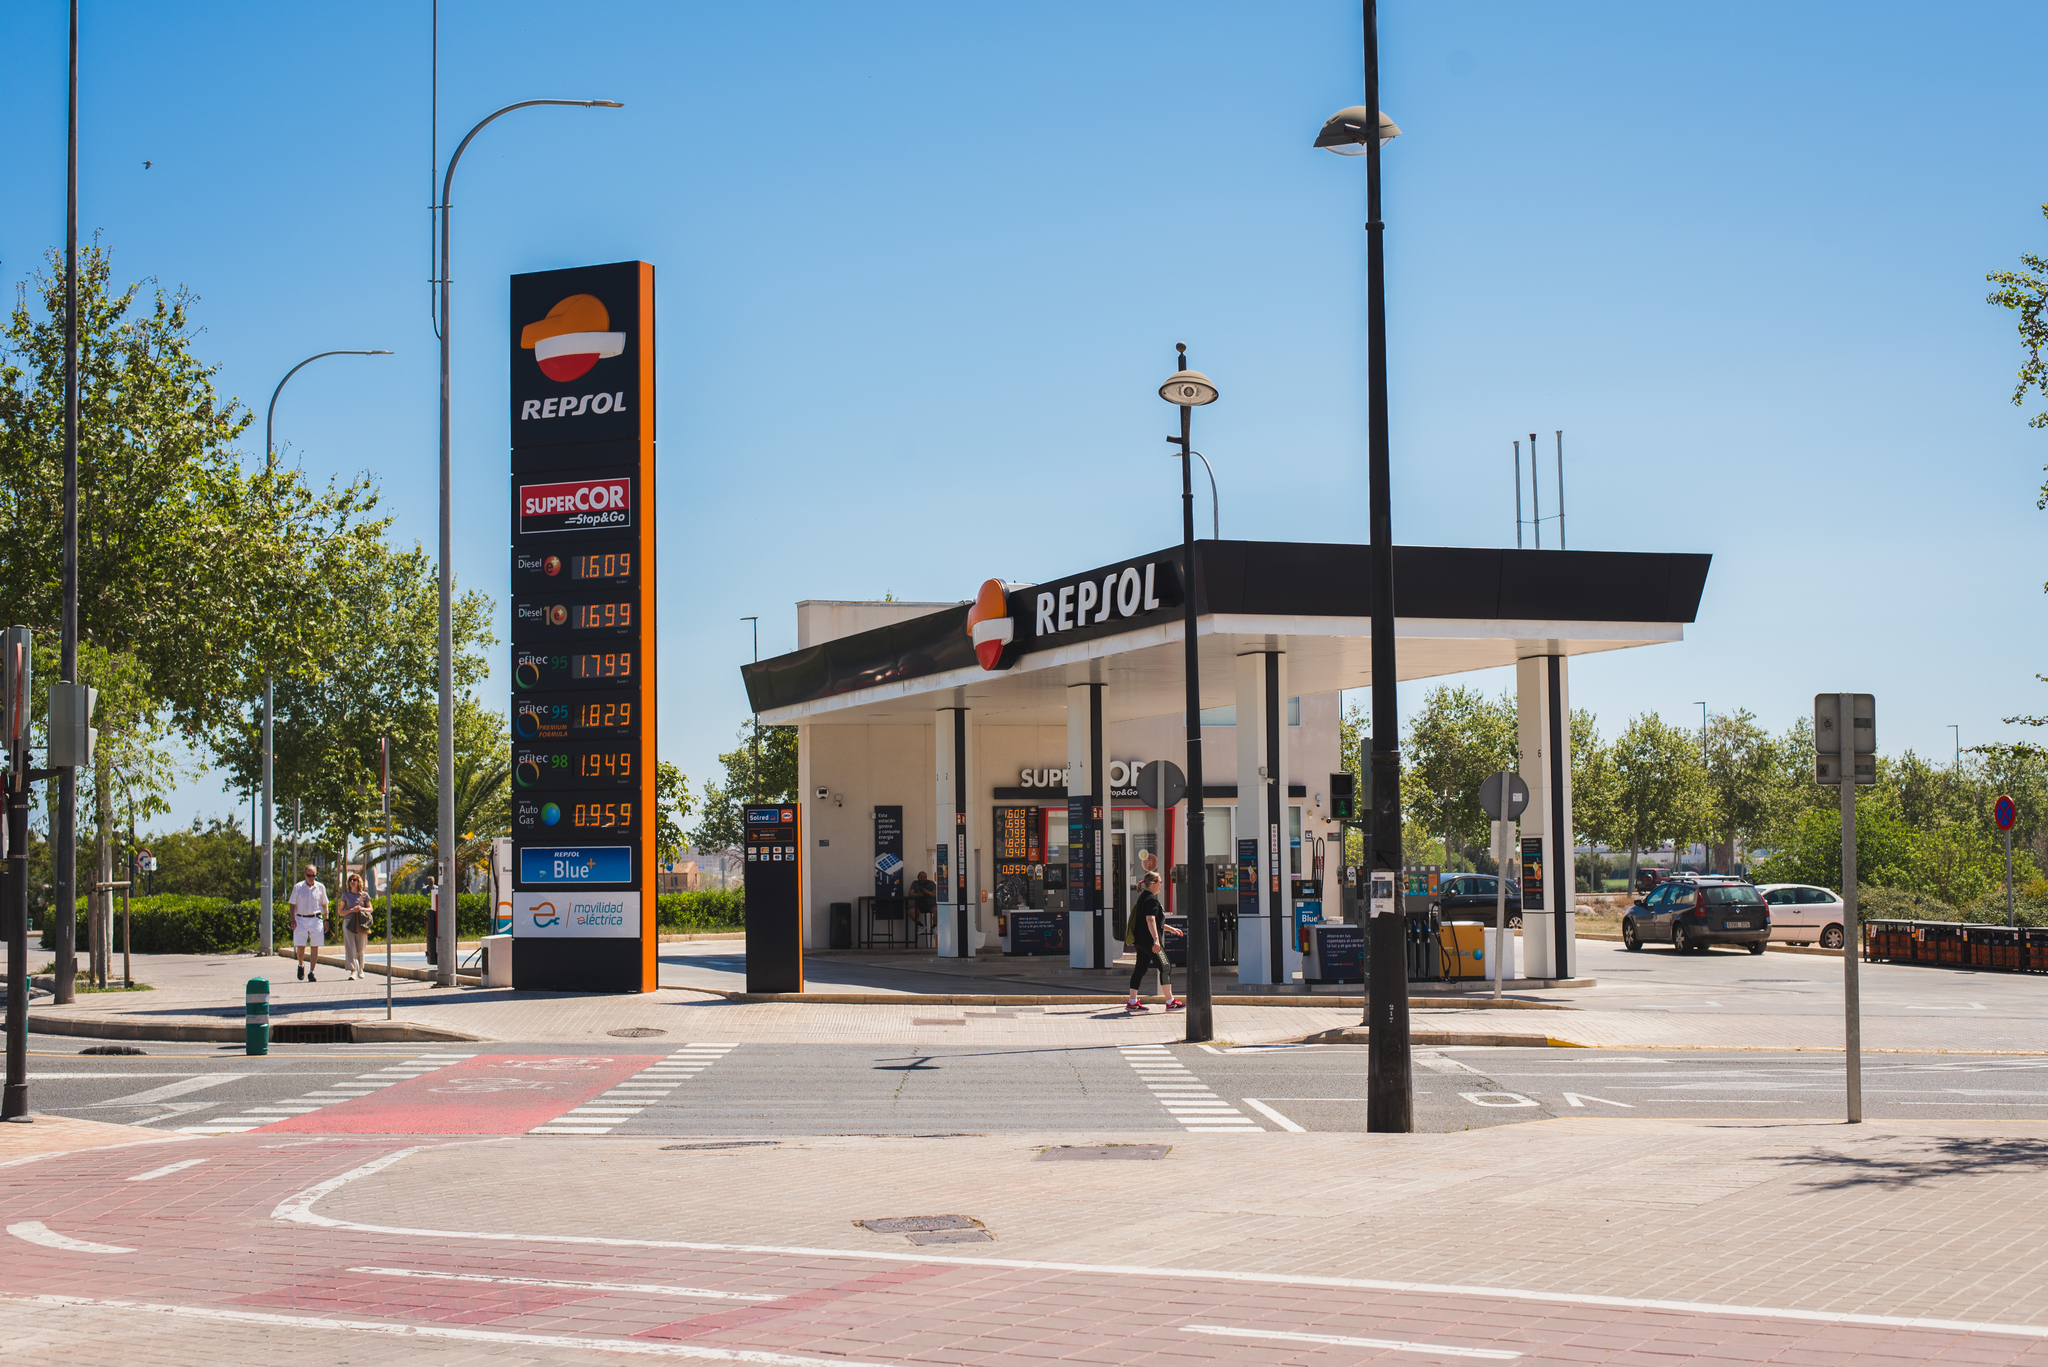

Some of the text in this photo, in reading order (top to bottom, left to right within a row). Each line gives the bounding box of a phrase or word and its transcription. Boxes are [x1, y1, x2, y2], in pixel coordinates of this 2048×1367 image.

[521, 392, 627, 420] REPSOL
[525, 485, 625, 514] SUPERCOR
[575, 511, 626, 526] Stop&Go
[518, 558, 542, 569] Diesel
[581, 553, 631, 578] 1.609
[1035, 562, 1160, 637] REPSOL
[518, 607, 543, 618] Diesel
[581, 603, 631, 628] 1.699
[518, 655, 568, 670] efitec 95
[581, 653, 631, 677] 1.799
[518, 704, 569, 719] efitec 95
[581, 702, 631, 727] 1.829
[518, 754, 568, 769] efitec 98
[581, 752, 631, 777] 1.949
[518, 804, 539, 814] Auto
[575, 803, 631, 827] 0.959
[1004, 809, 1026, 819] 1.609
[518, 814, 535, 825] Gas
[1004, 819, 1026, 829] 1.699
[1004, 828, 1026, 838] 1.799
[1004, 838, 1026, 848] 1.829
[1004, 848, 1026, 857] 1.949
[1002, 864, 1027, 874] 0.959
[574, 902, 623, 914] movilidad
[576, 913, 623, 926] eléctrica
